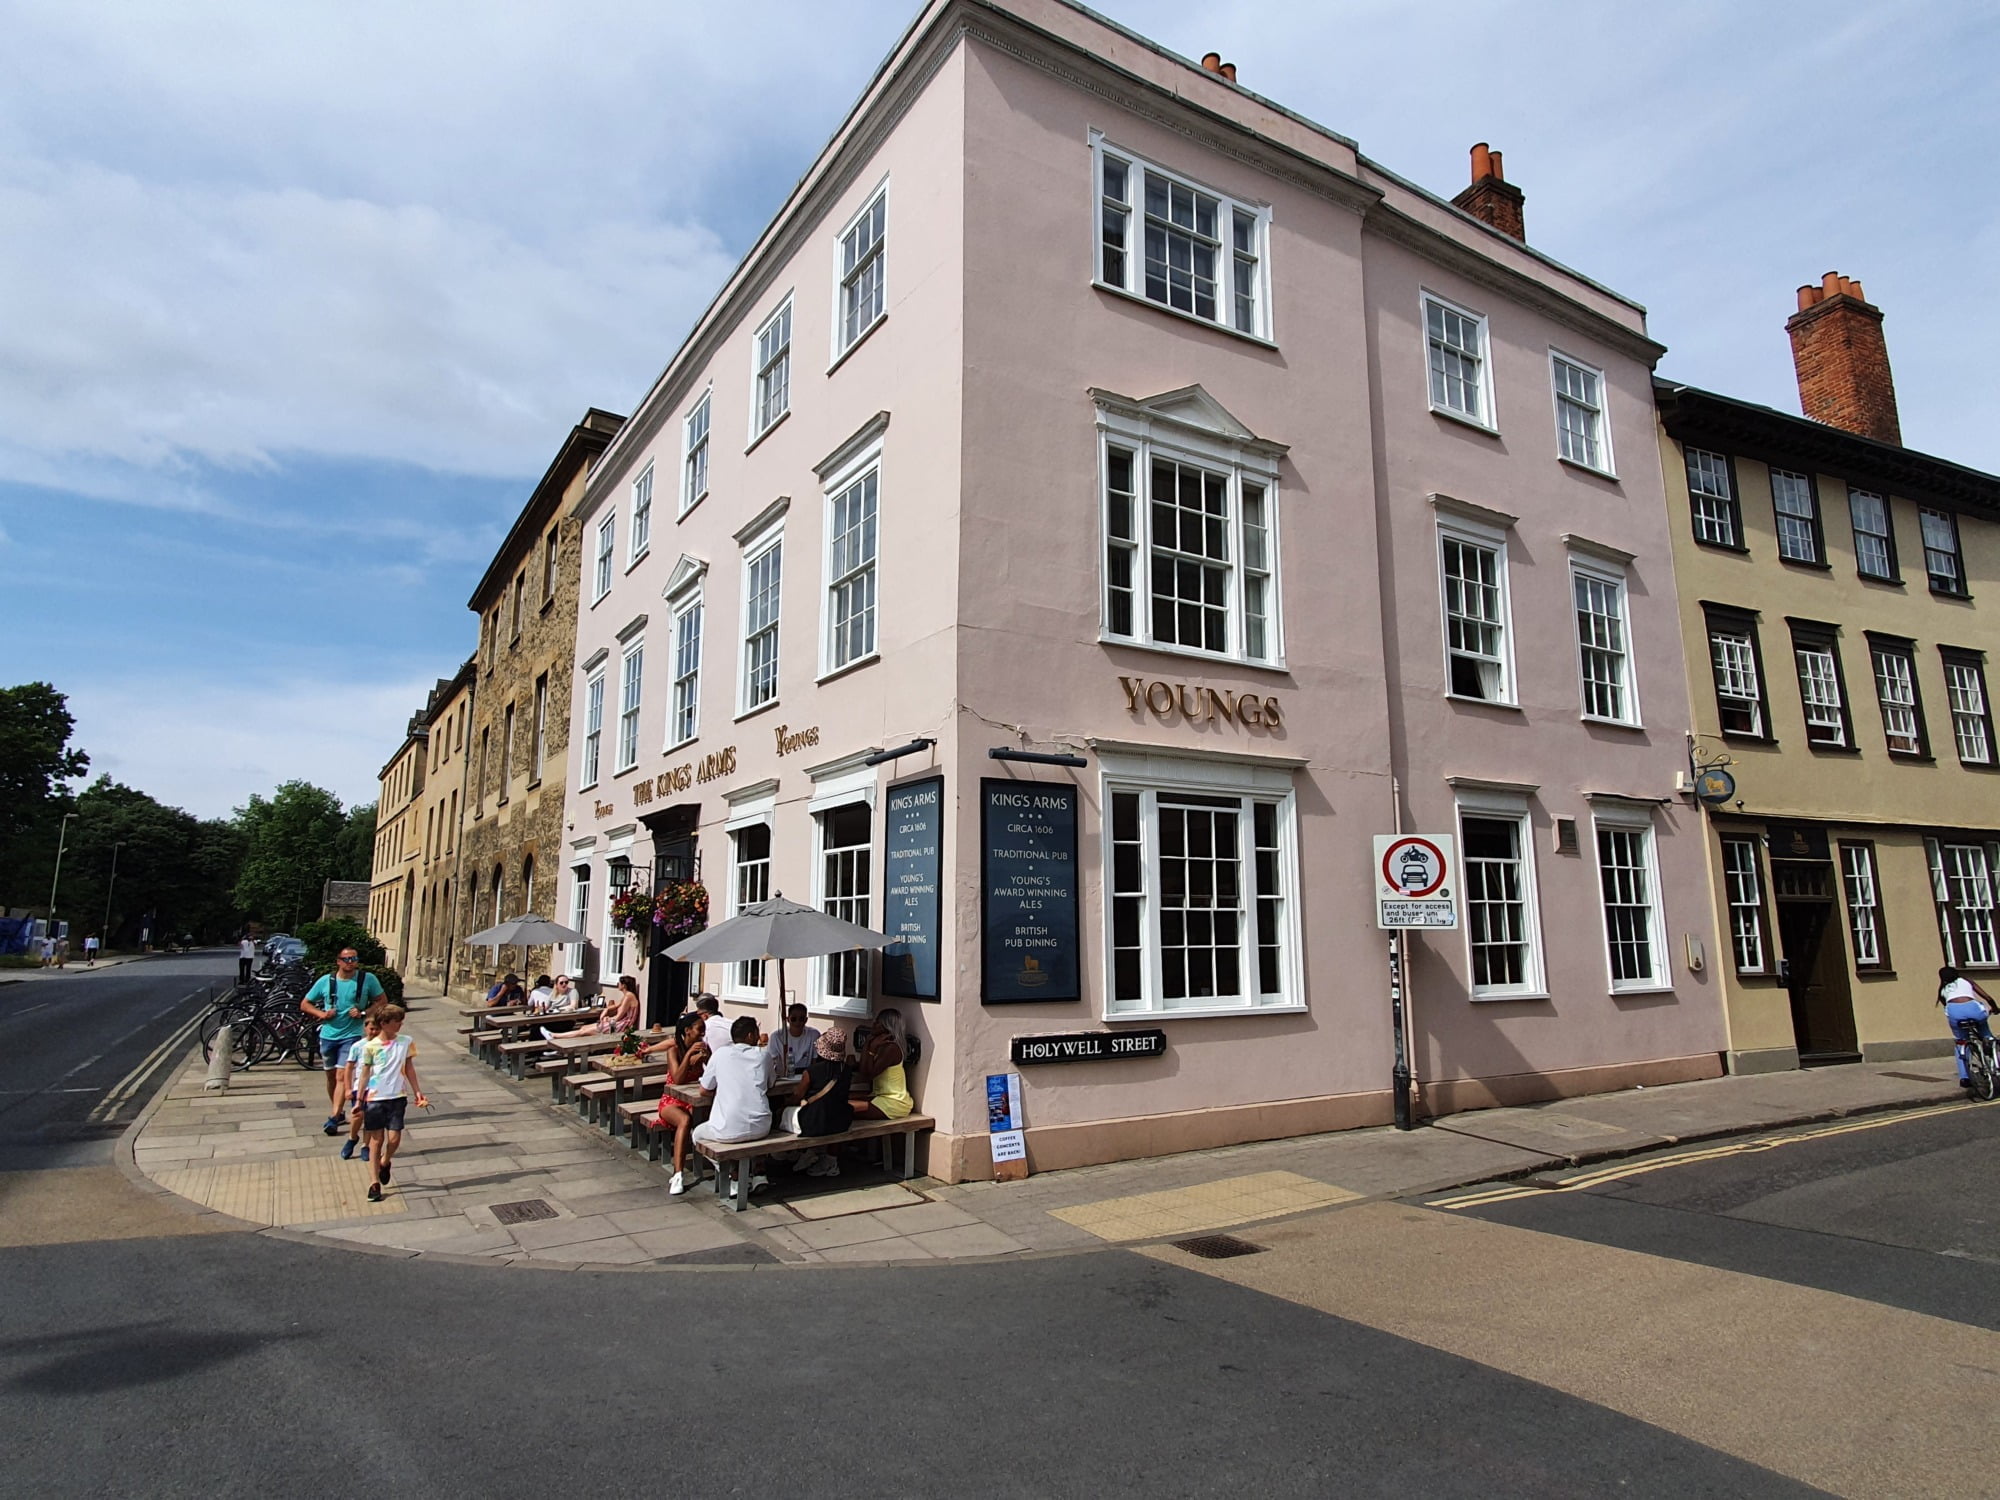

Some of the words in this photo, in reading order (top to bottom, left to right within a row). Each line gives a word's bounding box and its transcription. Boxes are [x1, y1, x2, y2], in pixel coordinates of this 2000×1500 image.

[1118, 676, 1281, 728] YOUNGS
[774, 724, 819, 758] YOUNGS
[633, 779, 653, 807] THE
[656, 763, 692, 799] KINGS
[696, 745, 736, 785] ARMS
[914, 791, 936, 807] ARMS
[992, 793, 1031, 808] KING'S
[1032, 796, 1068, 810] ARMS
[899, 824, 914, 834] CIRCA
[914, 822, 927, 832] 1606
[1007, 823, 1033, 833] CIRCA
[1034, 825, 1054, 834] 1606
[891, 848, 922, 859] TRADITIONAL
[923, 846, 935, 856] PUB
[993, 849, 1050, 860] TRADITIONAL
[1051, 851, 1068, 860] PUB
[1010, 876, 1051, 886] YOUNG'S
[890, 886, 909, 895] AWARD
[910, 884, 934, 894] WINNING
[994, 887, 1025, 897] AWARD
[1026, 889, 1068, 898] WINNING
[904, 897, 919, 906] ALES
[1019, 900, 1043, 909] ALES
[900, 923, 921, 932] BRITISH
[1015, 926, 1048, 935] BRITISH
[907, 935, 927, 944] DINING
[1005, 938, 1023, 948] PUB
[1025, 938, 1057, 948] DINING
[1022, 1041, 1102, 1059] HOLYWELL
[1111, 1036, 1158, 1052] STREET
